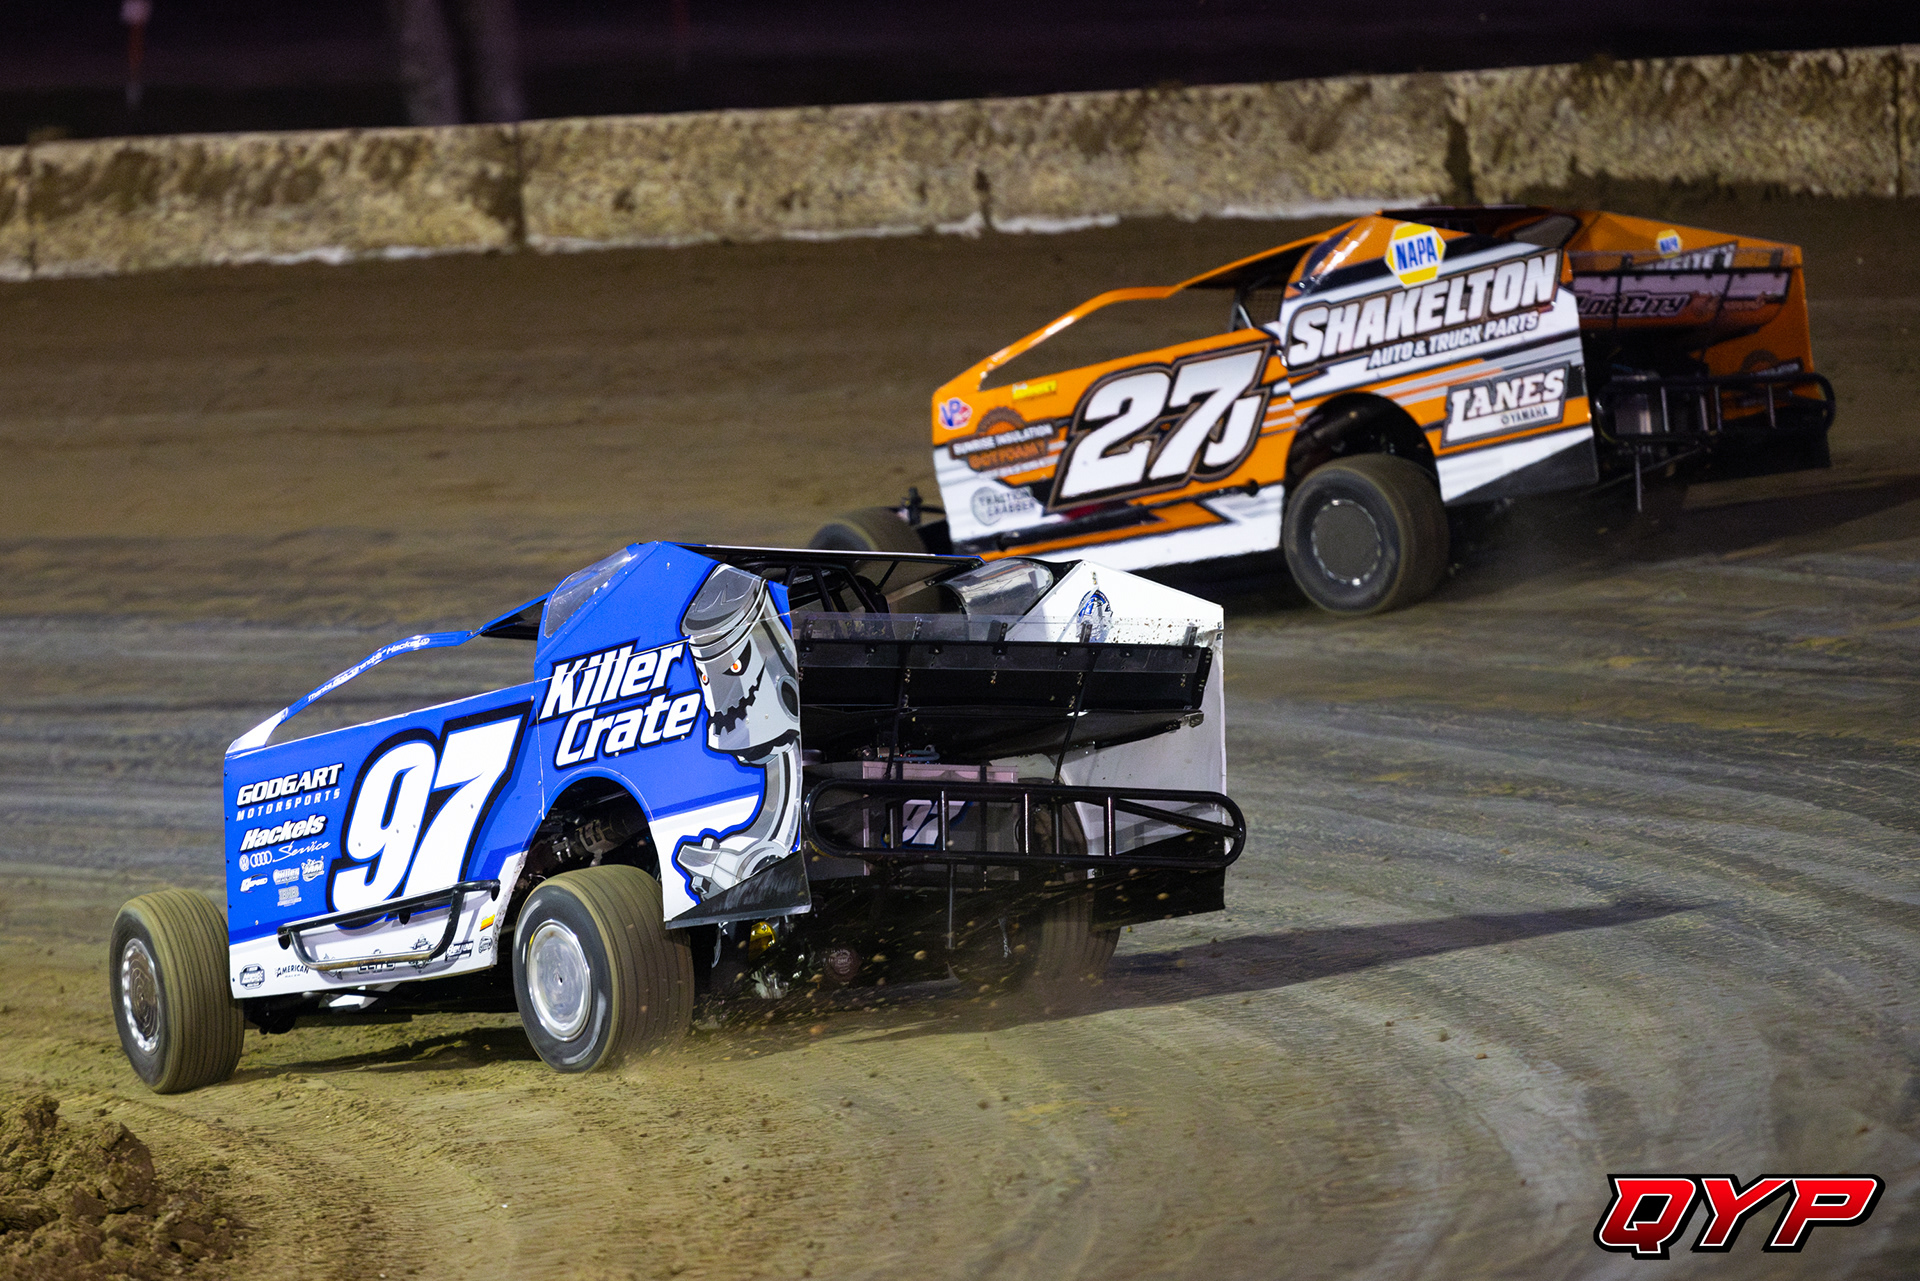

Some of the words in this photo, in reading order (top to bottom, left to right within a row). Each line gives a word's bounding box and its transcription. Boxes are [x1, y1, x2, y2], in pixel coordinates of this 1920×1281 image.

[1394, 235, 1439, 271] NAPA
[1287, 251, 1559, 366] SHAKELTON
[1368, 341, 1413, 369] AUTO
[1414, 338, 1427, 357] &
[1427, 325, 1481, 355] TRUCK
[1483, 312, 1540, 340] PARTS
[1445, 368, 1566, 442] LANES
[1511, 405, 1549, 424] YAMAHA
[995, 424, 1054, 446] INSULATION
[539, 644, 686, 719] Killer
[555, 692, 702, 767] Crate
[236, 763, 344, 807] GODGART
[236, 788, 341, 822] MOTORSPORTS
[240, 814, 327, 852] Hackels
[332, 718, 521, 915] 97
[272, 840, 331, 863] Service
[275, 964, 310, 978] AMERICAN
